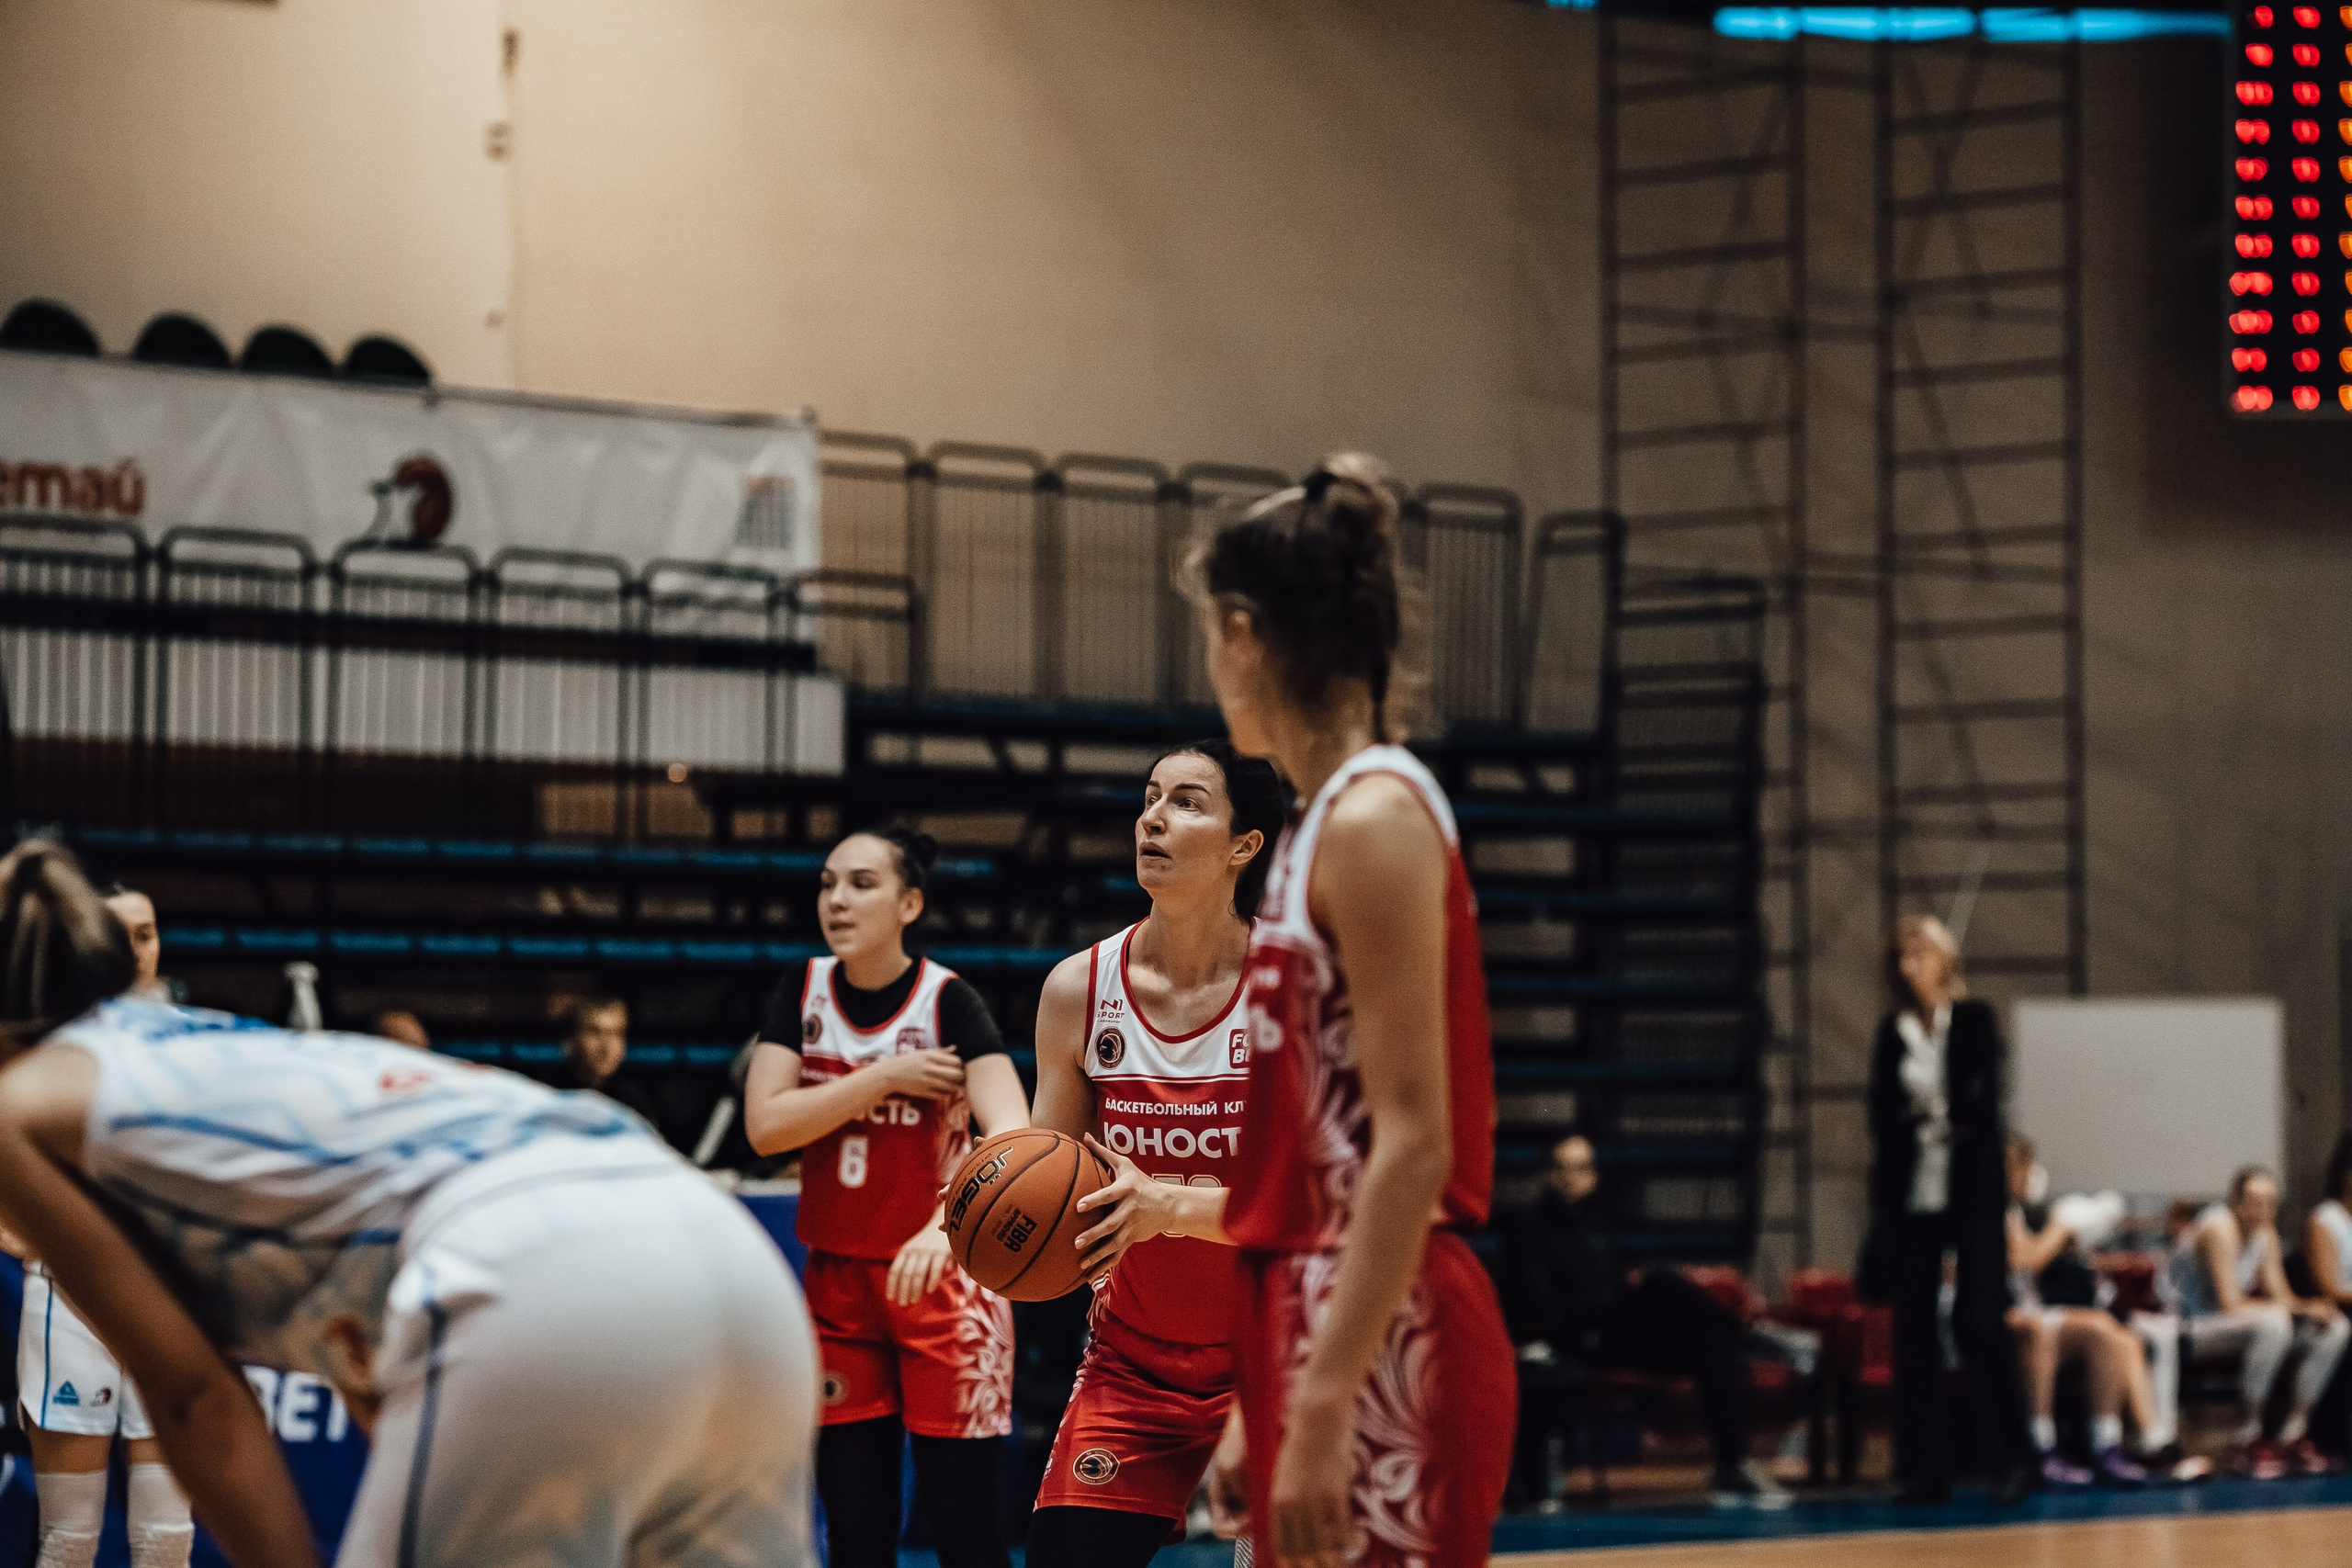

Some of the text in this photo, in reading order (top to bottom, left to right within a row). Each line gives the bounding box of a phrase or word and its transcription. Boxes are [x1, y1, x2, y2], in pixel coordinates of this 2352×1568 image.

[1105, 1097, 1245, 1115] БАСКЕТБОЛЬНЫЙ КЛ
[1103, 1122, 1242, 1158] ЮНОСТ
[838, 1135, 868, 1189] 6
[996, 1208, 1022, 1242] APPROVED
[1003, 1214, 1037, 1253] FIBA
